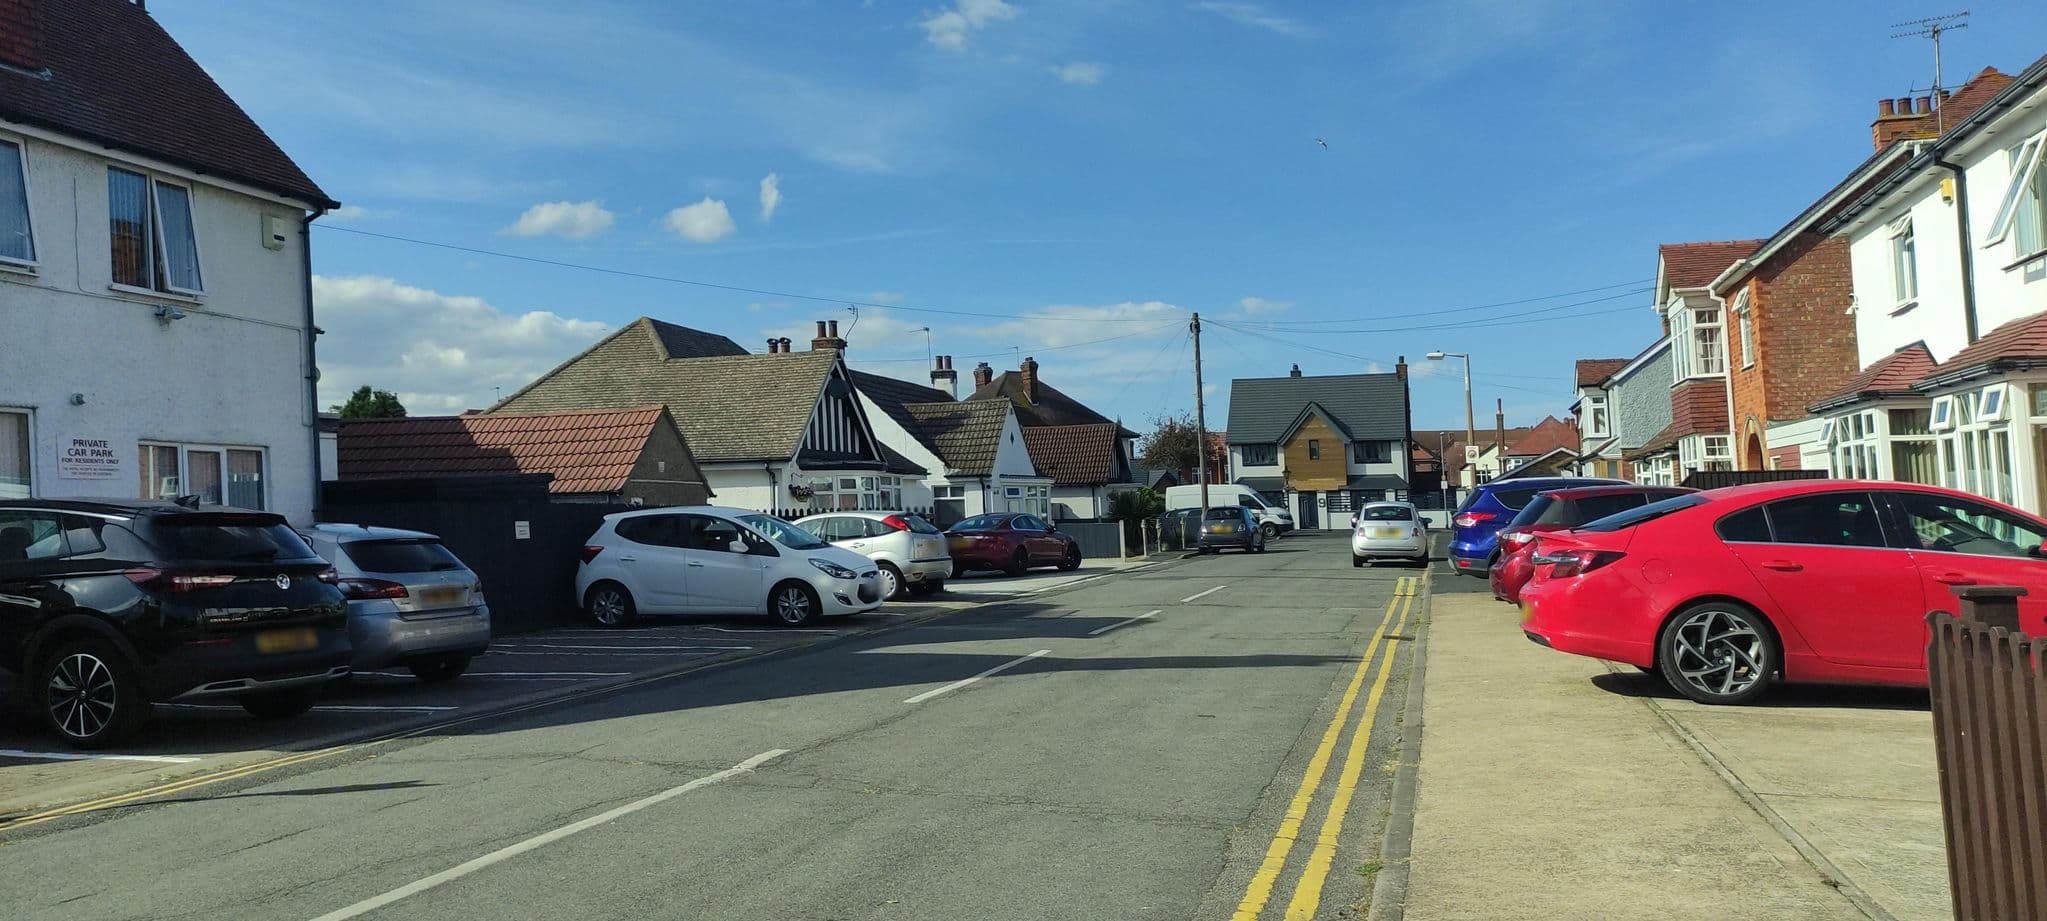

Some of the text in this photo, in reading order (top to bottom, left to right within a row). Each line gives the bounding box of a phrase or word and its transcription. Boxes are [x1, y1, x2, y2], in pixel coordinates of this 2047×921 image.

[73, 439, 109, 448] PRIVATE
[67, 448, 113, 457] CAR PARK
[1318, 498, 1326, 508] 9
